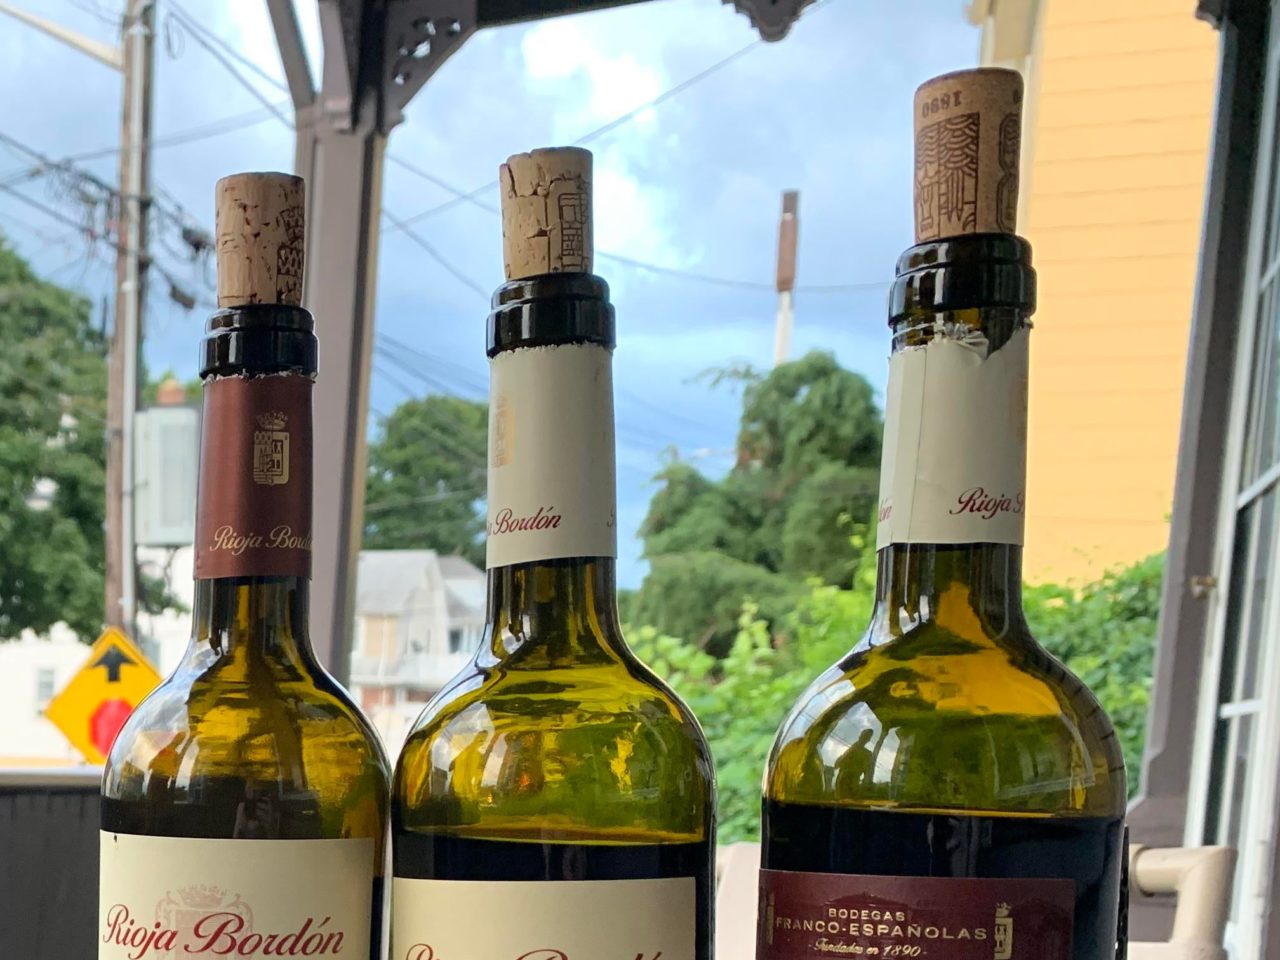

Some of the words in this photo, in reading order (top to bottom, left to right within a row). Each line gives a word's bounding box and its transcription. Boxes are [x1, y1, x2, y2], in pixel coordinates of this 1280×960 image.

[949, 486, 1012, 520] Rioja
[493, 506, 562, 535] Bordón
[210, 525, 263, 556] Rioja
[776, 916, 988, 940] FRANCO-ESPAÑOLAS
[828, 908, 906, 922] BODEGAS
[102, 904, 178, 960] Rioja
[184, 912, 345, 957] Bordón
[883, 945, 921, 957] 1890
